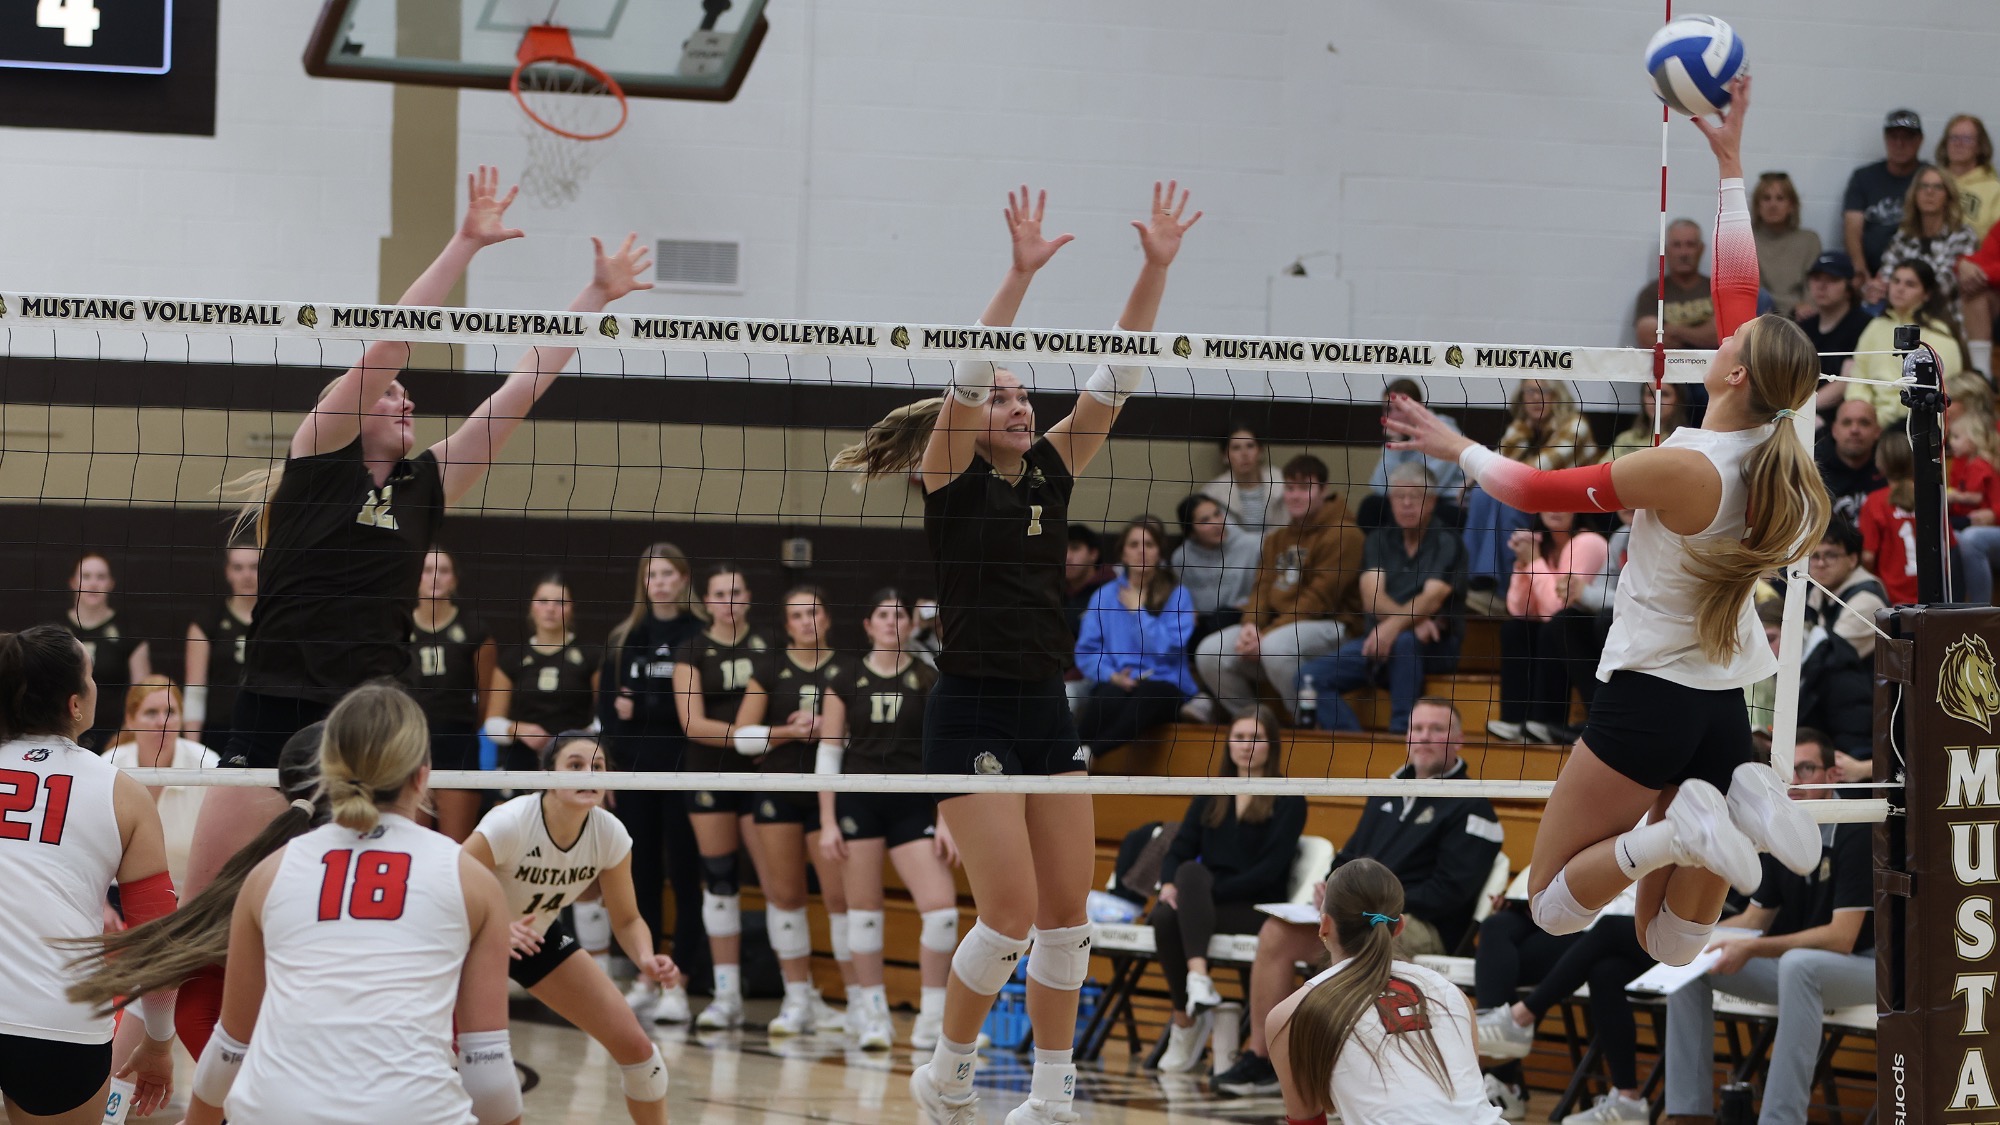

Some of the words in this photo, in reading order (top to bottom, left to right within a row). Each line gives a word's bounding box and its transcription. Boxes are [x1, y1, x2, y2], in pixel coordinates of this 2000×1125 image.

[19, 295, 137, 320] MUSTANG
[143, 300, 285, 326] VOLLEYBALL
[330, 306, 443, 331] MUSTANG
[448, 310, 588, 336] VOLLEYBALL
[630, 317, 740, 341] MUSTANG
[746, 321, 880, 347] VOLLEYBALL
[921, 327, 1028, 351] MUSTANG
[1033, 331, 1162, 357] VOLLEYBALL
[1202, 337, 1305, 361] MUSTANG
[1308, 341, 1436, 366] VOLLEYBALL
[1474, 347, 1573, 370] MUSTANG
[356, 485, 399, 530] 12
[1028, 505, 1043, 536] 1
[419, 645, 446, 676] 11
[870, 692, 903, 723] 17
[0, 768, 74, 846] 21
[318, 848, 412, 922] 18
[514, 865, 596, 886] MUSTANGS
[522, 893, 565, 914] 14
[1937, 746, 2000, 1125] MUSTA
